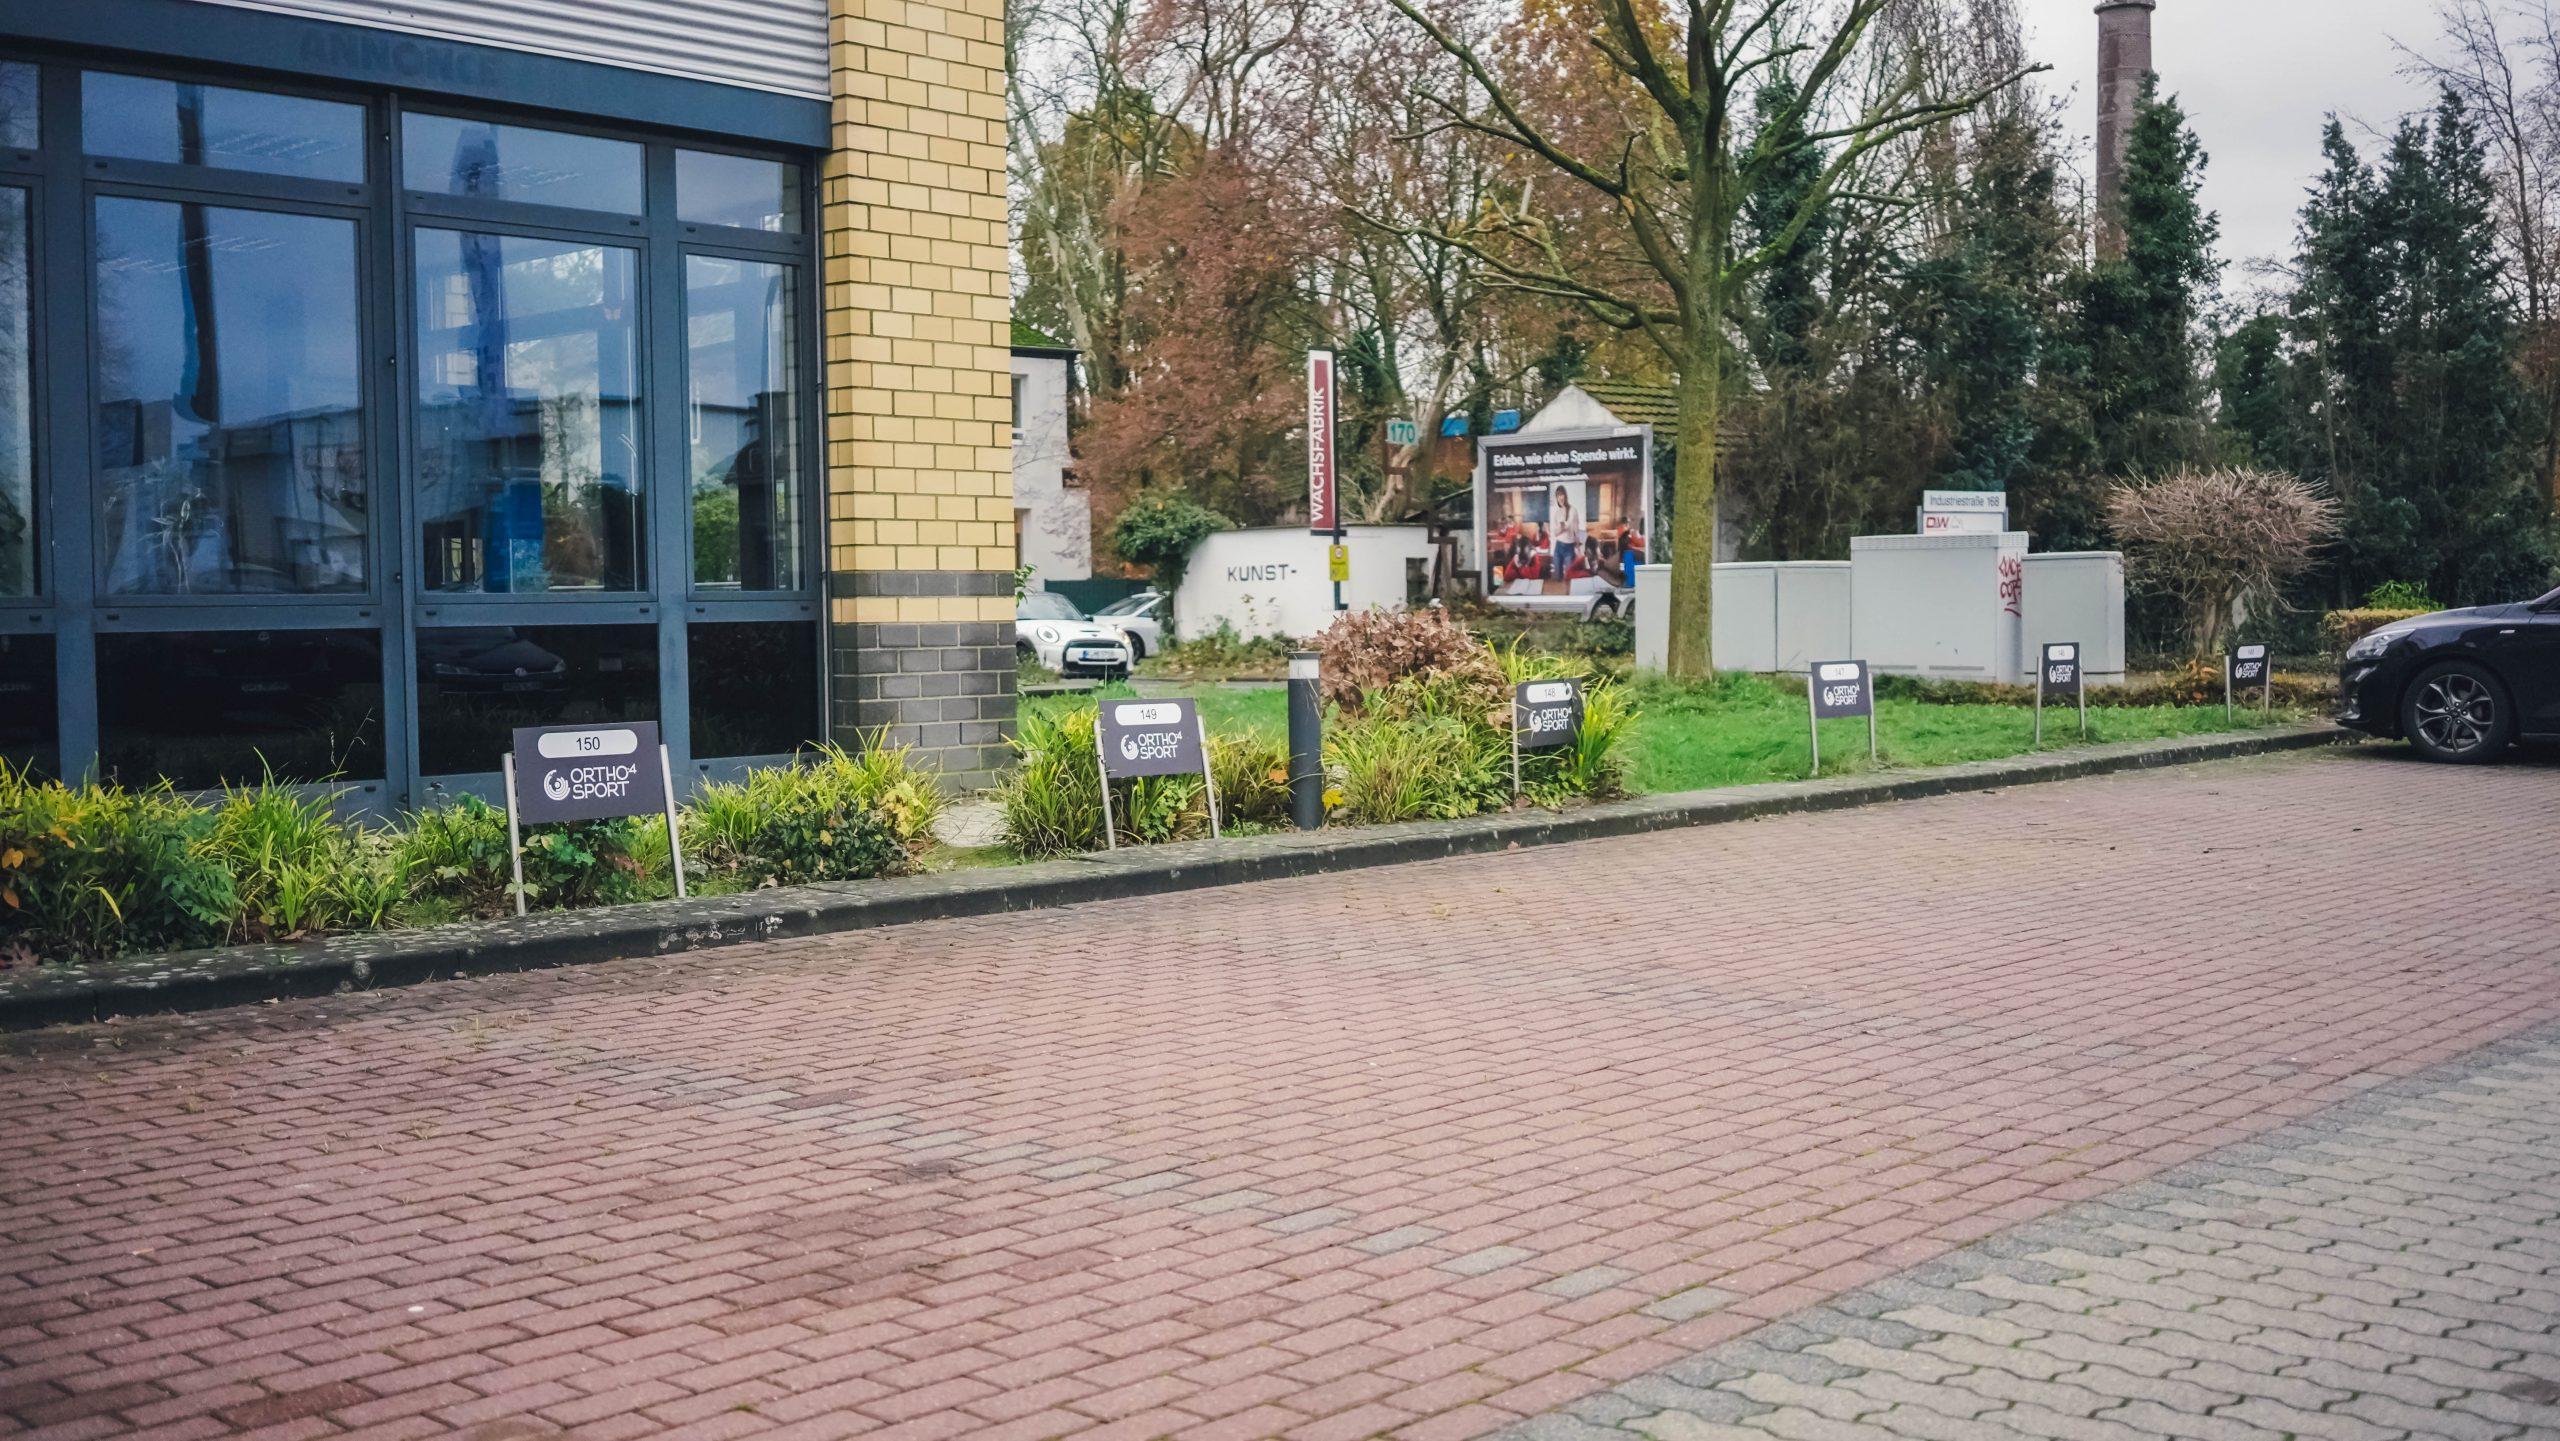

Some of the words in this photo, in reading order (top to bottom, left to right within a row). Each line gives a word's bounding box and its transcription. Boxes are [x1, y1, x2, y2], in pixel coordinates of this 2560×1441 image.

[1390, 423, 1416, 443] 170
[1311, 387, 1325, 522] WACHSFABRIK
[1493, 454, 1525, 467] Erlebe,
[1525, 453, 1542, 465] wie
[1543, 452, 1570, 464] deine
[1570, 448, 1607, 465] Spende
[1608, 447, 1638, 460] wirkt.
[1930, 495, 1984, 507] Industriestraße
[1227, 563, 1297, 582] KUNST-
[1544, 688, 1556, 699] 148
[1834, 695, 1858, 706] SPORT
[1140, 708, 1157, 720] 149
[1542, 719, 1569, 732] SPORT
[576, 736, 600, 751] 150
[1140, 745, 1178, 760] SPORT
[572, 781, 630, 799] SPORT
